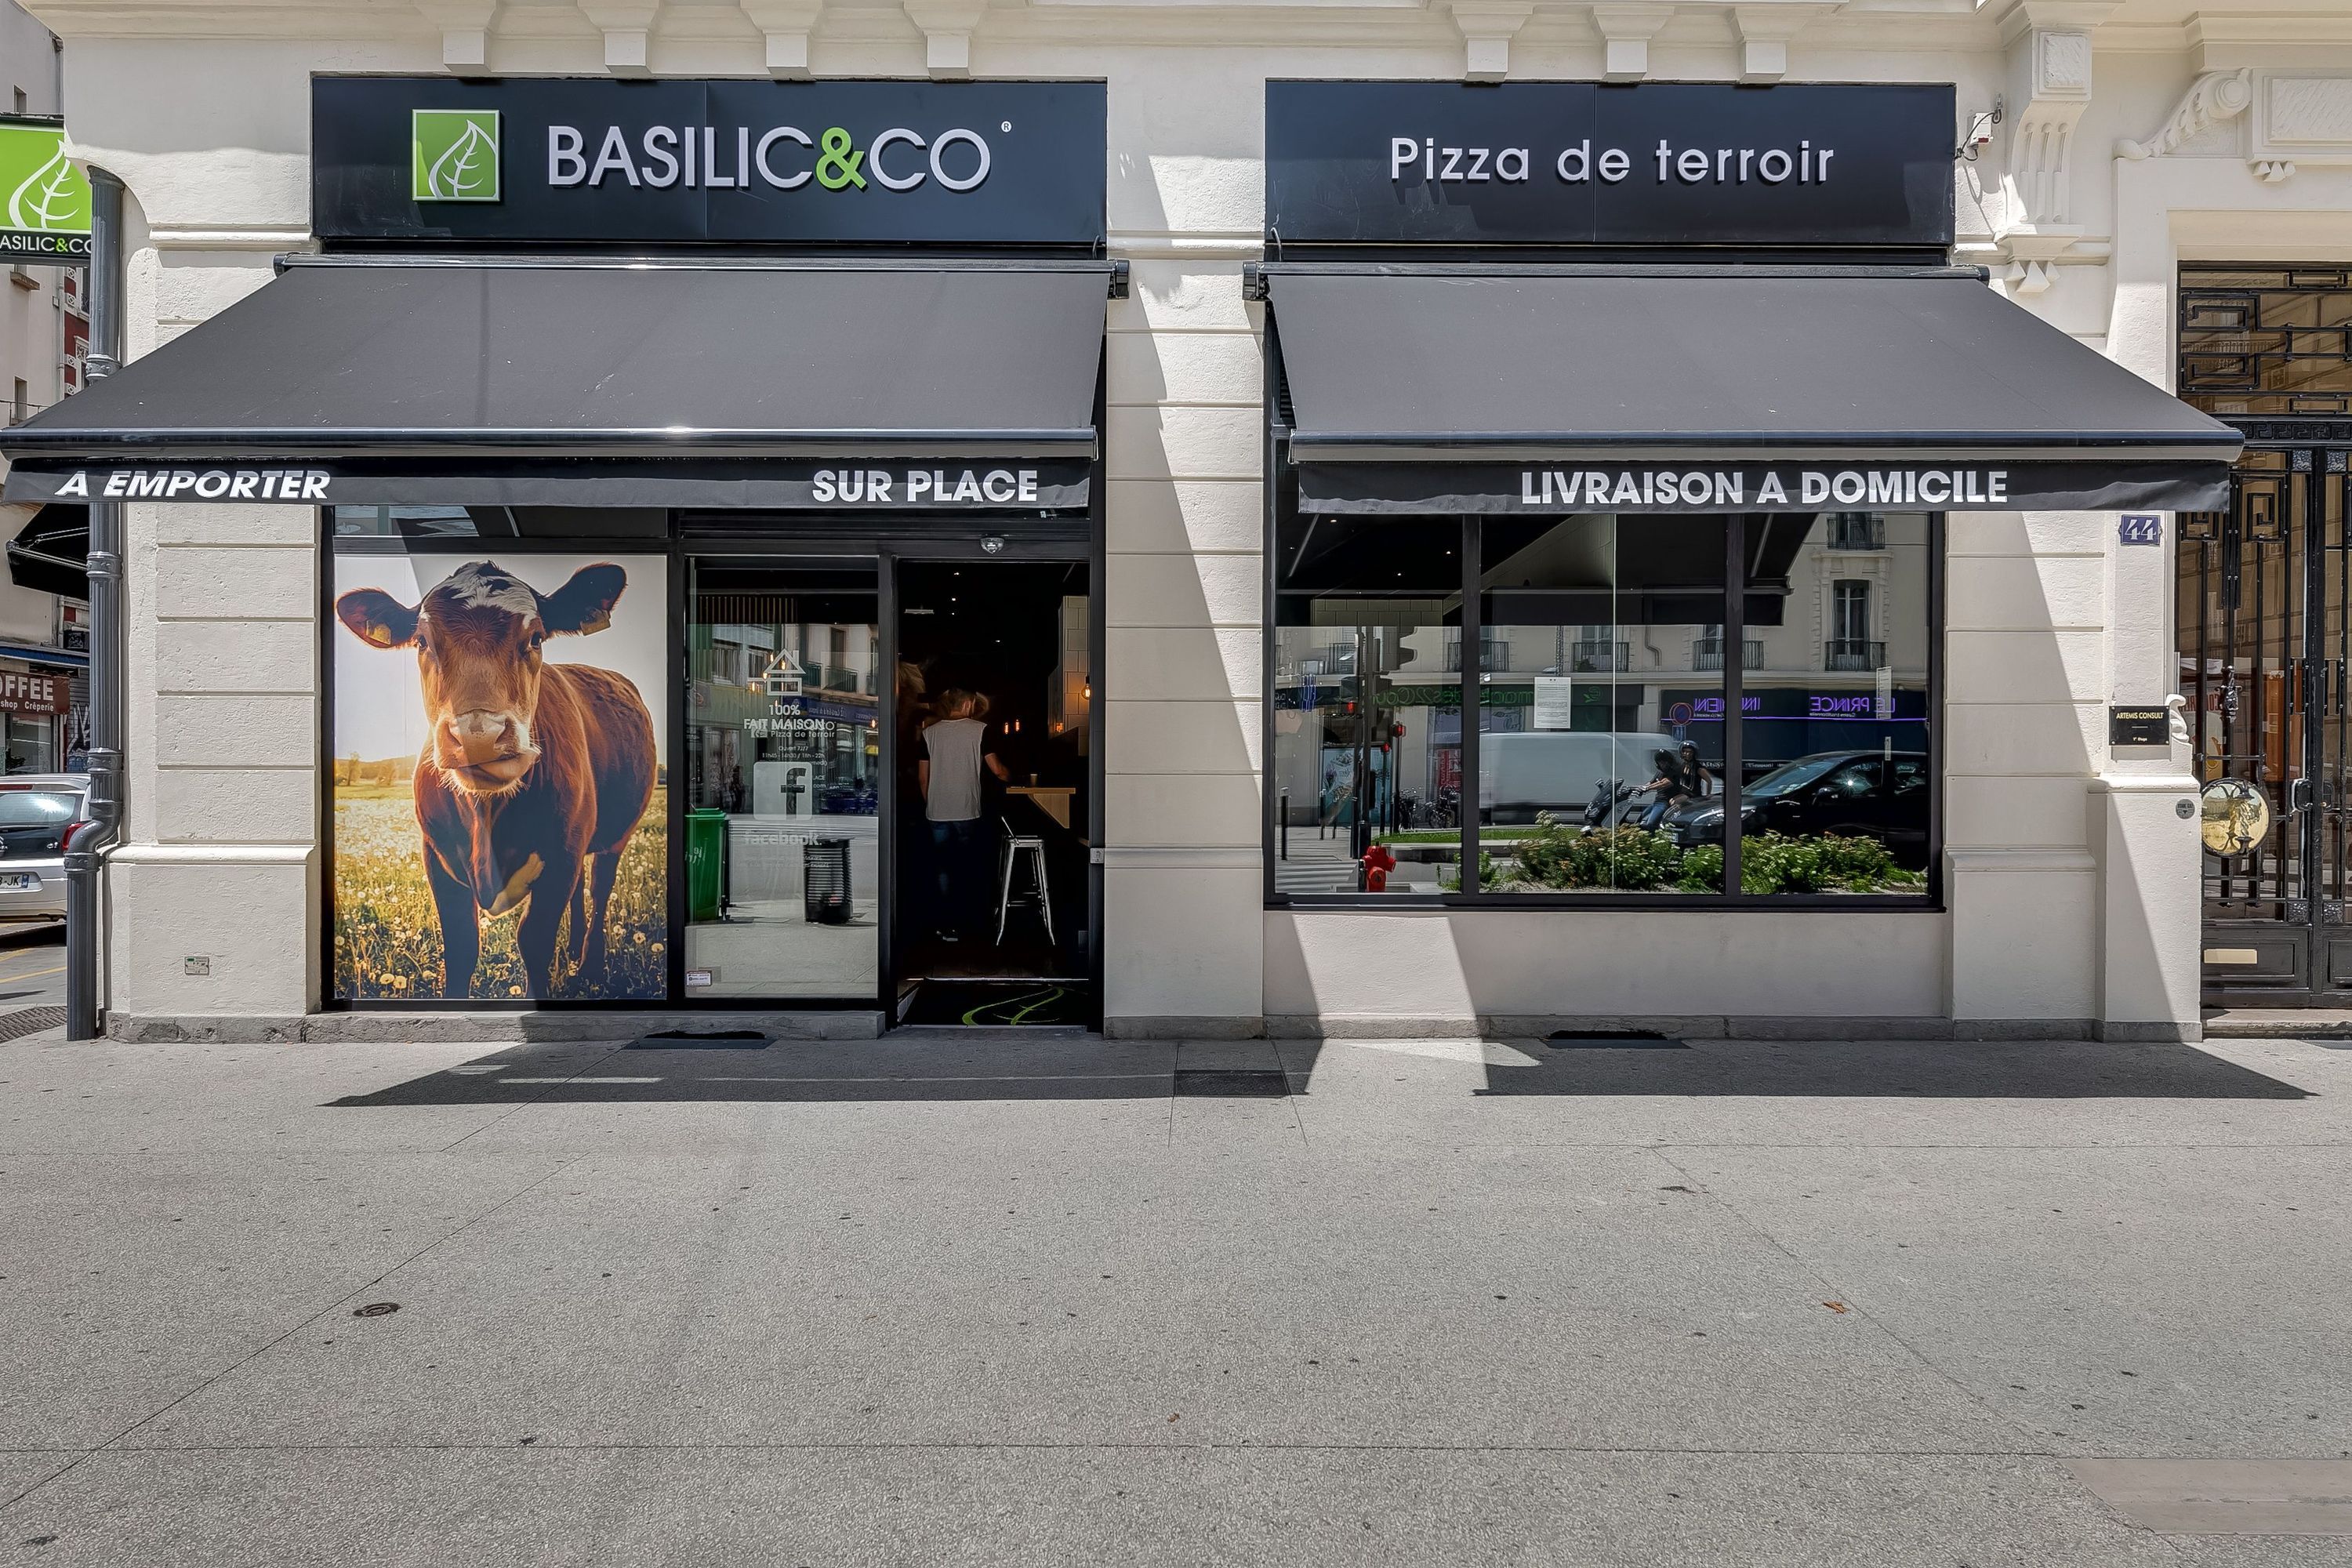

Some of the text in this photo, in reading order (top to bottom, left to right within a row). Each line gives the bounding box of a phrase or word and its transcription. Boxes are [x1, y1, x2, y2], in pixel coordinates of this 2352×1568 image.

[549, 125, 991, 191] BASILIC&CO
[1391, 137, 1835, 183] Pizza de terroir
[54, 470, 331, 499] A EMPORTER
[812, 470, 1037, 502] SUR PLACE
[1521, 470, 2008, 505] LIVRAISON A DOMICILE
[2125, 519, 2157, 540] 44
[0, 675, 54, 701] FFEE
[743, 718, 826, 731] FAIT MAISON
[768, 704, 800, 716] 100%
